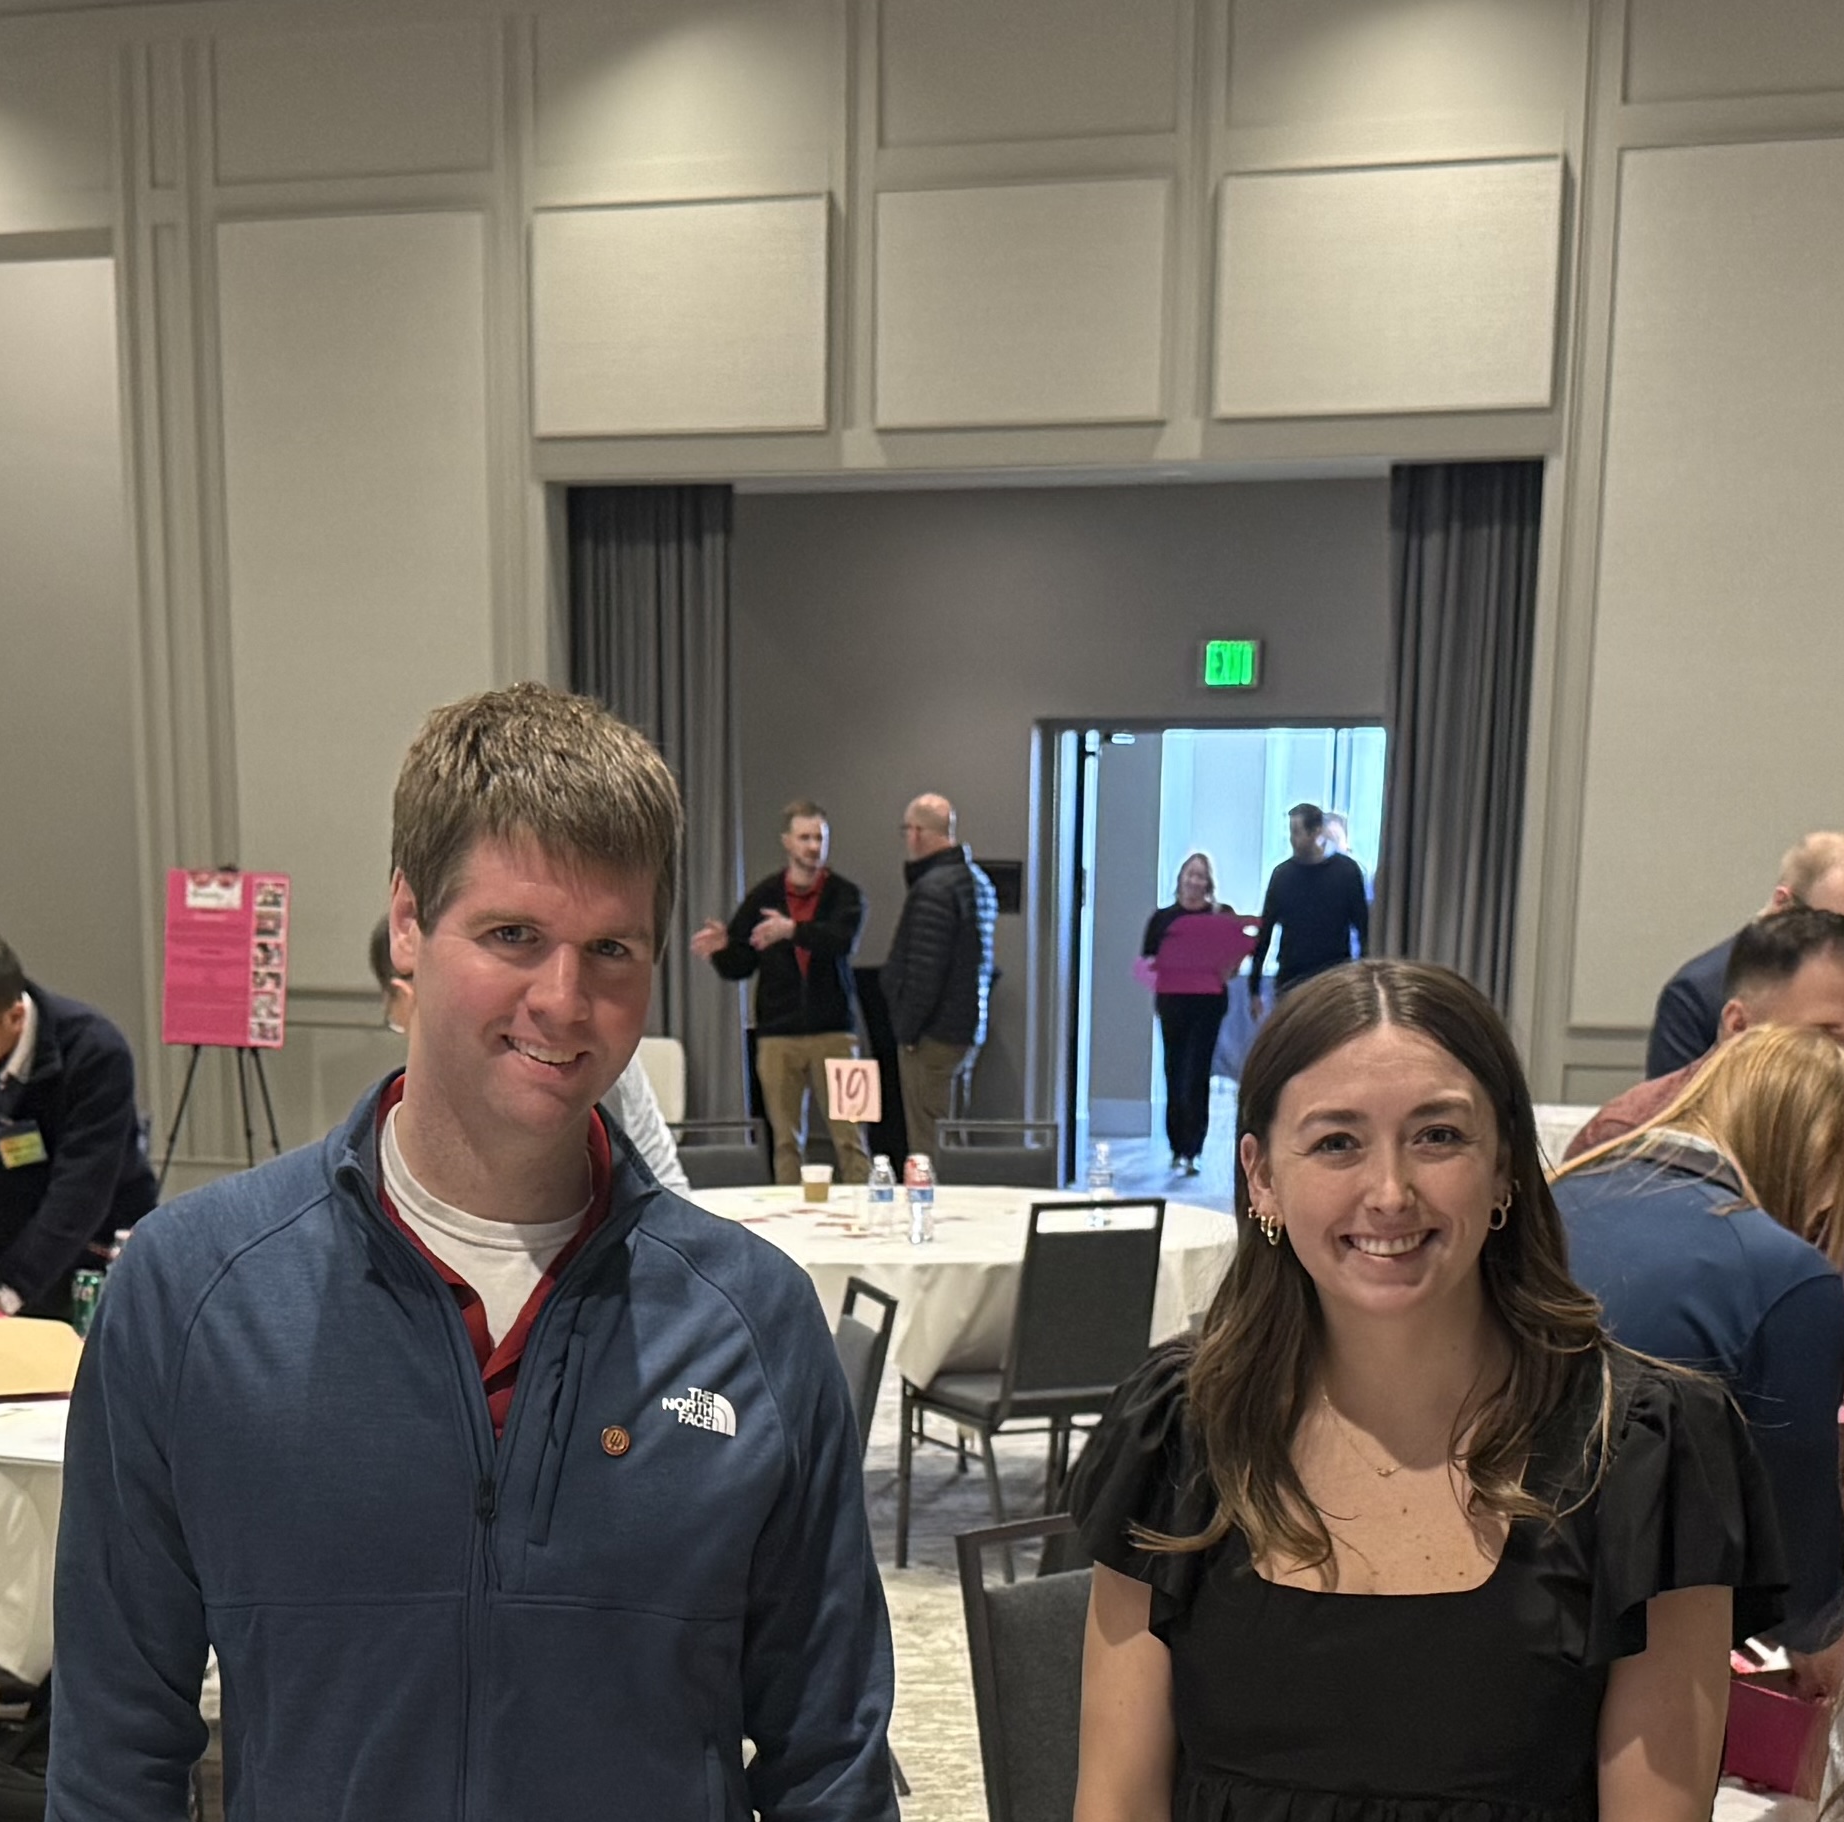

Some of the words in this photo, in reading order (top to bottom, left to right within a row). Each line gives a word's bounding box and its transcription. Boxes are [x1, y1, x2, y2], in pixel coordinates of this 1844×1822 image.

[835, 1067, 870, 1116] 19
[687, 1387, 714, 1402] THE
[662, 1397, 714, 1416] NORTH
[678, 1411, 714, 1430] FACE
